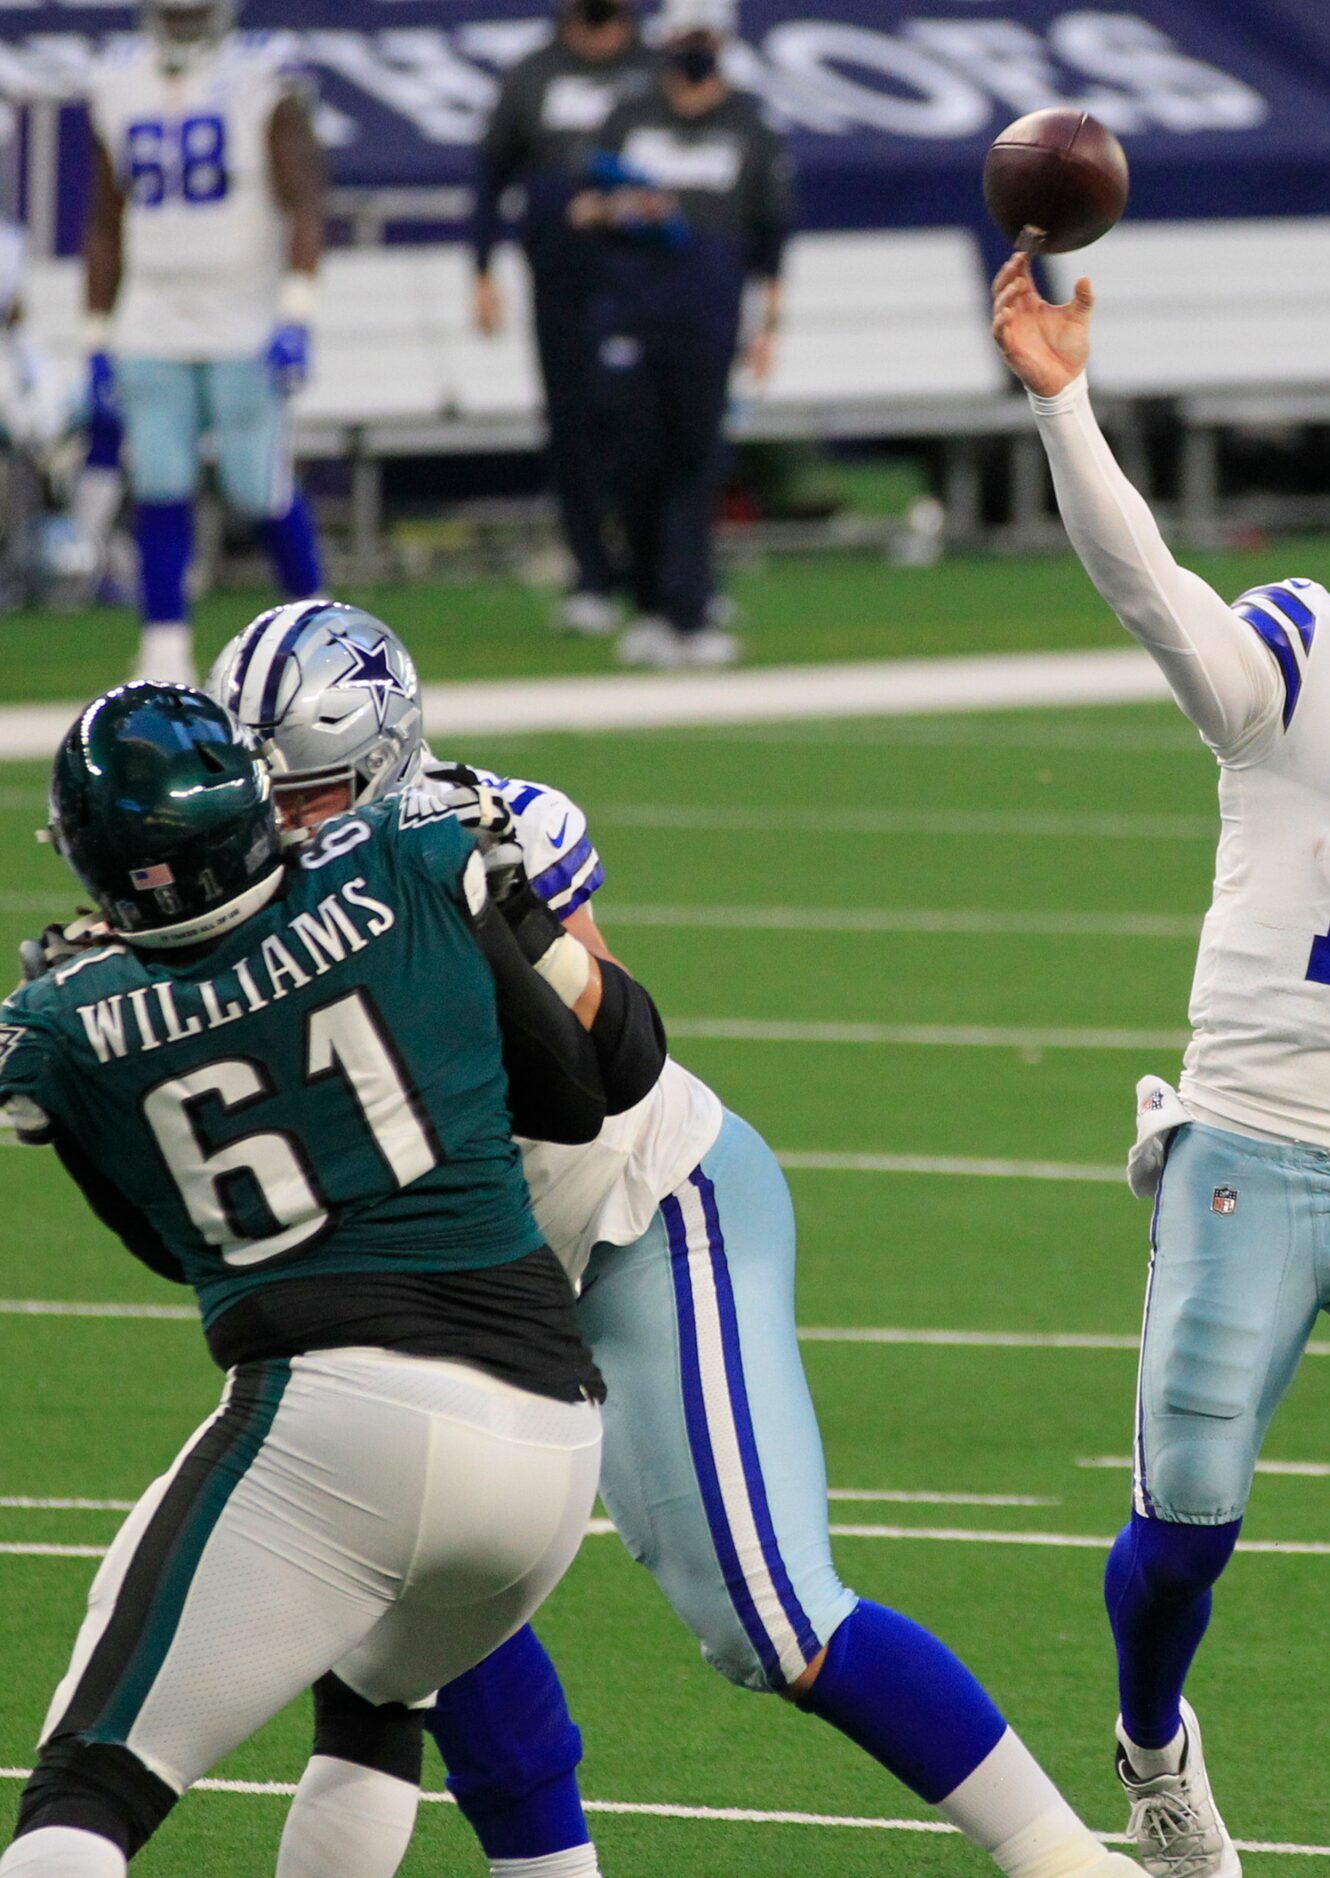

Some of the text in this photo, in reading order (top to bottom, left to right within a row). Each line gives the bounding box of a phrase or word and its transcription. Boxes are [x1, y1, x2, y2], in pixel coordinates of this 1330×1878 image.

[128, 115, 228, 207] 68
[75, 876, 396, 1065] WILLIAMS
[141, 987, 443, 1270] 61
